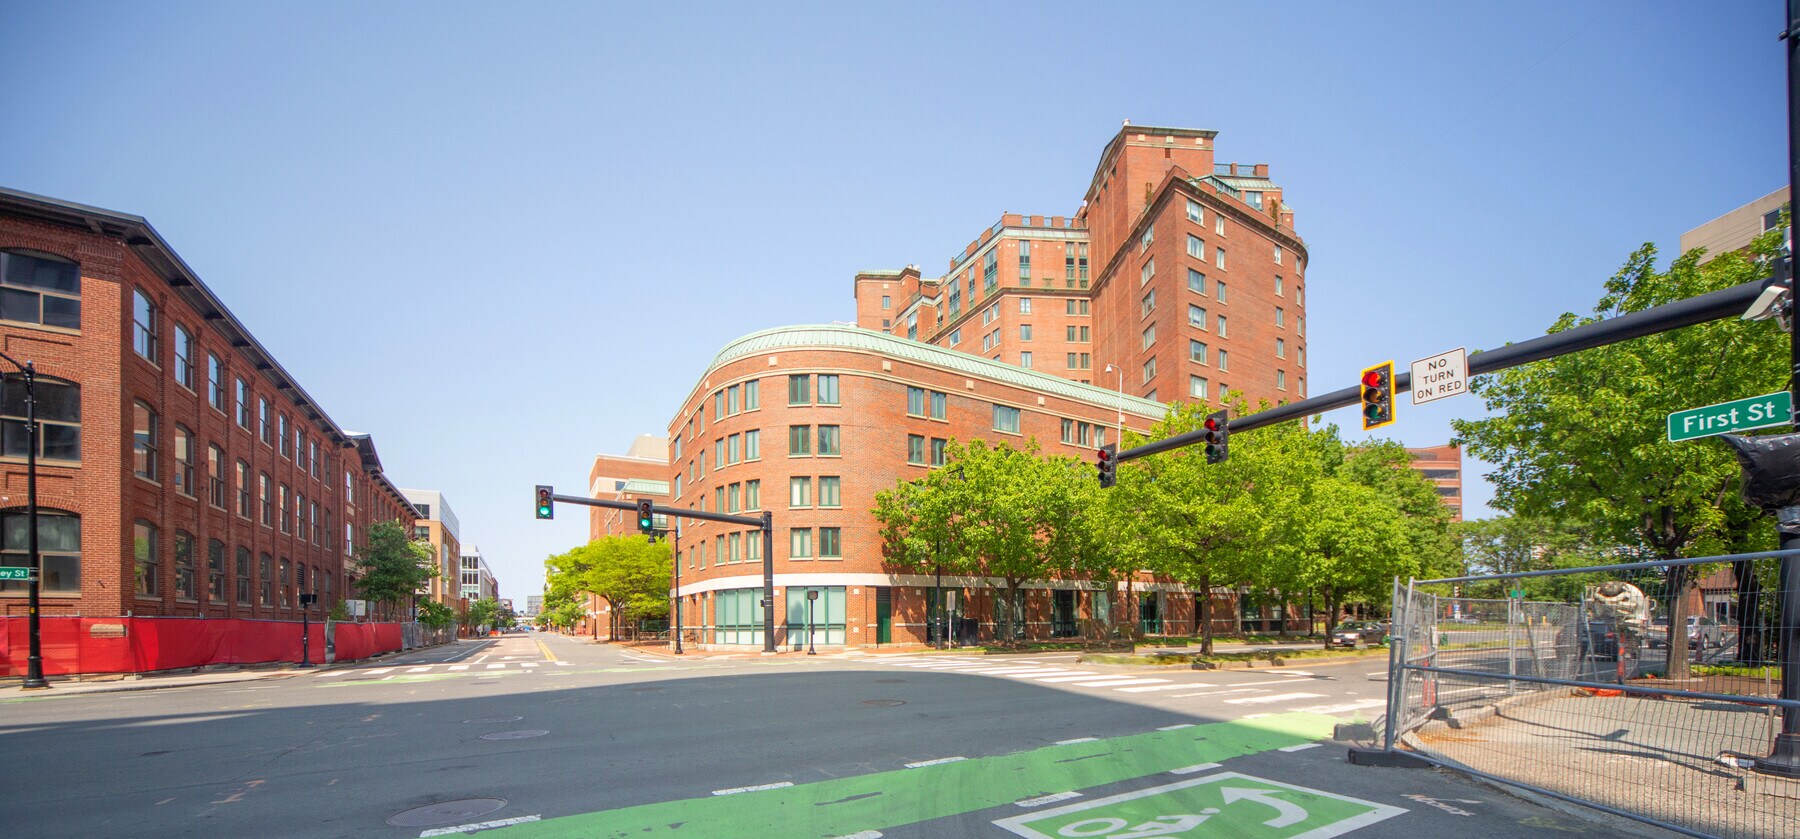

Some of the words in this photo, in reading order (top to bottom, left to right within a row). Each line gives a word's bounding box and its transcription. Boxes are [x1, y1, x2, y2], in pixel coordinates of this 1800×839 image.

[1428, 358, 1447, 371] NO
[1423, 369, 1454, 384] TURN
[1417, 388, 1433, 399] ON
[1439, 380, 1462, 393] RED
[1684, 408, 1739, 433] First
[1747, 401, 1776, 421] St
[14, 569, 25, 577] St
